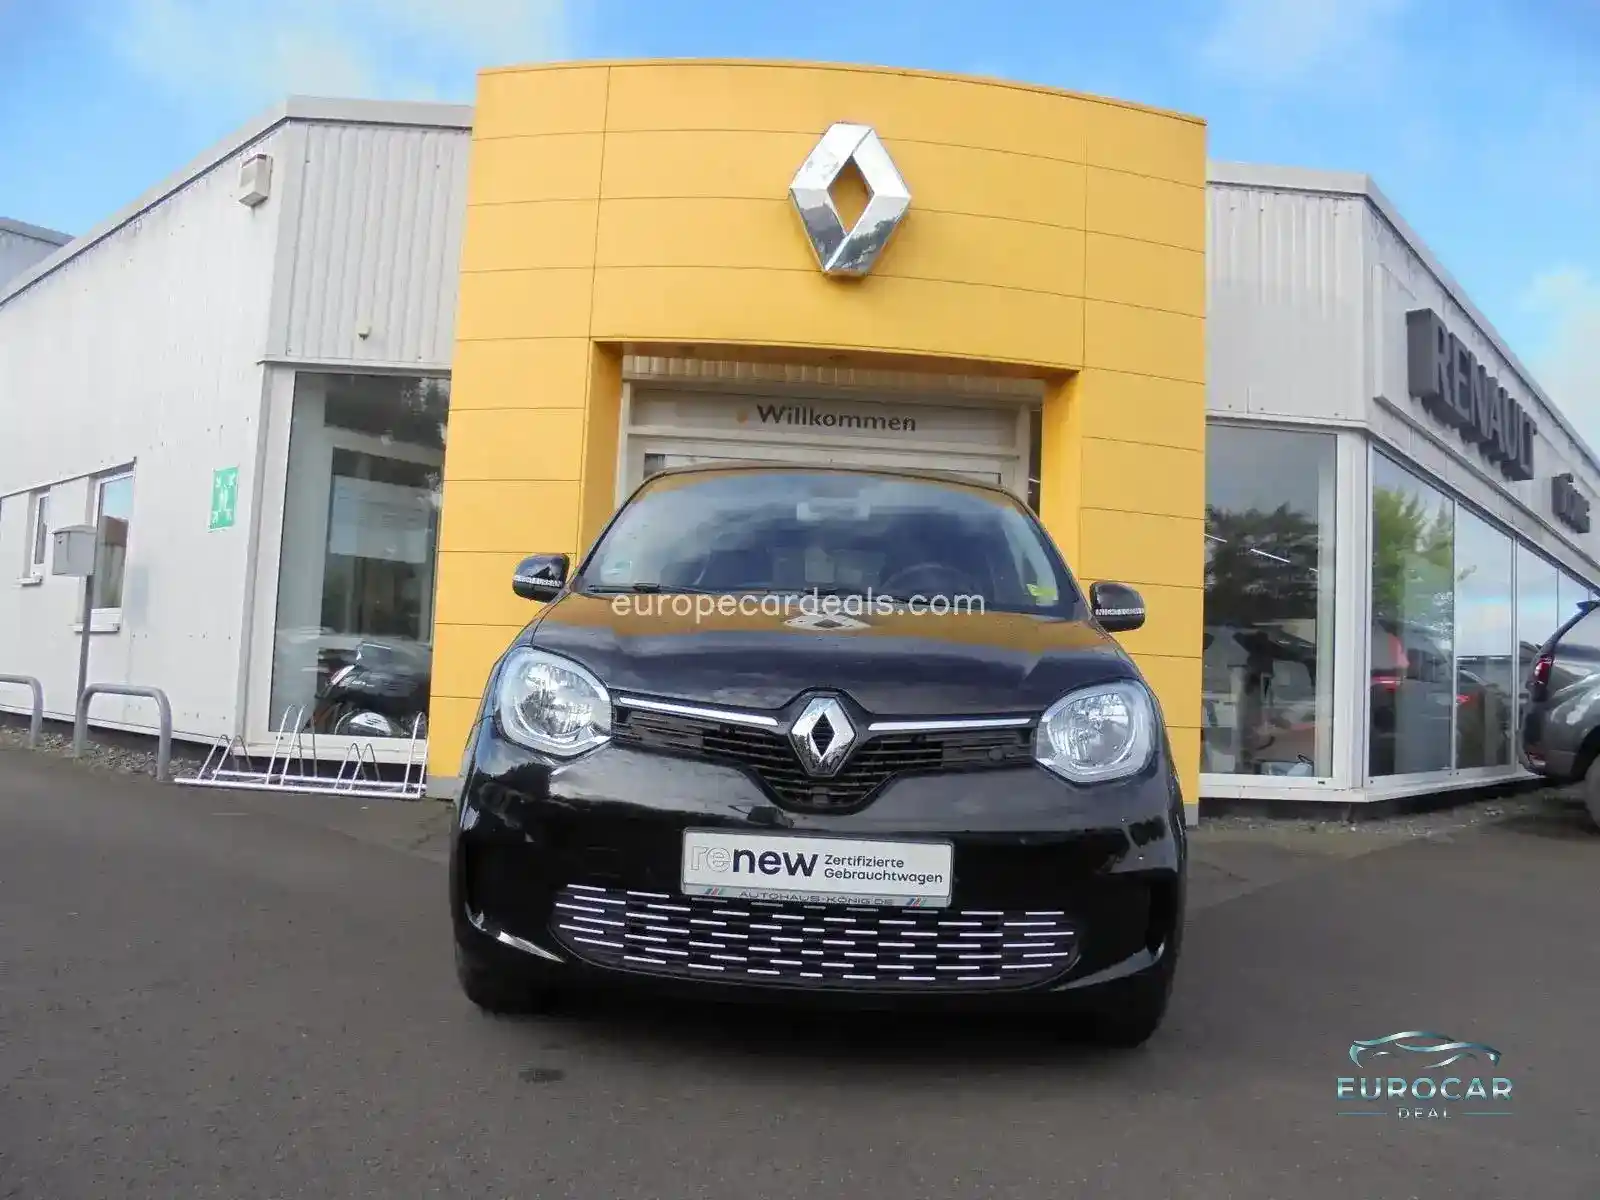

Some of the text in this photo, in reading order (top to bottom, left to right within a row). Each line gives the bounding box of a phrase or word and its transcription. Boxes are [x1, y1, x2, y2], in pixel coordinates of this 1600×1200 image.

[1406, 308, 1538, 481] RENAULT
[756, 403, 917, 432] Willkommen
[691, 845, 818, 877] renew
[824, 854, 904, 868] Zertifizierte
[824, 868, 943, 885] Gebrauchtwagen
